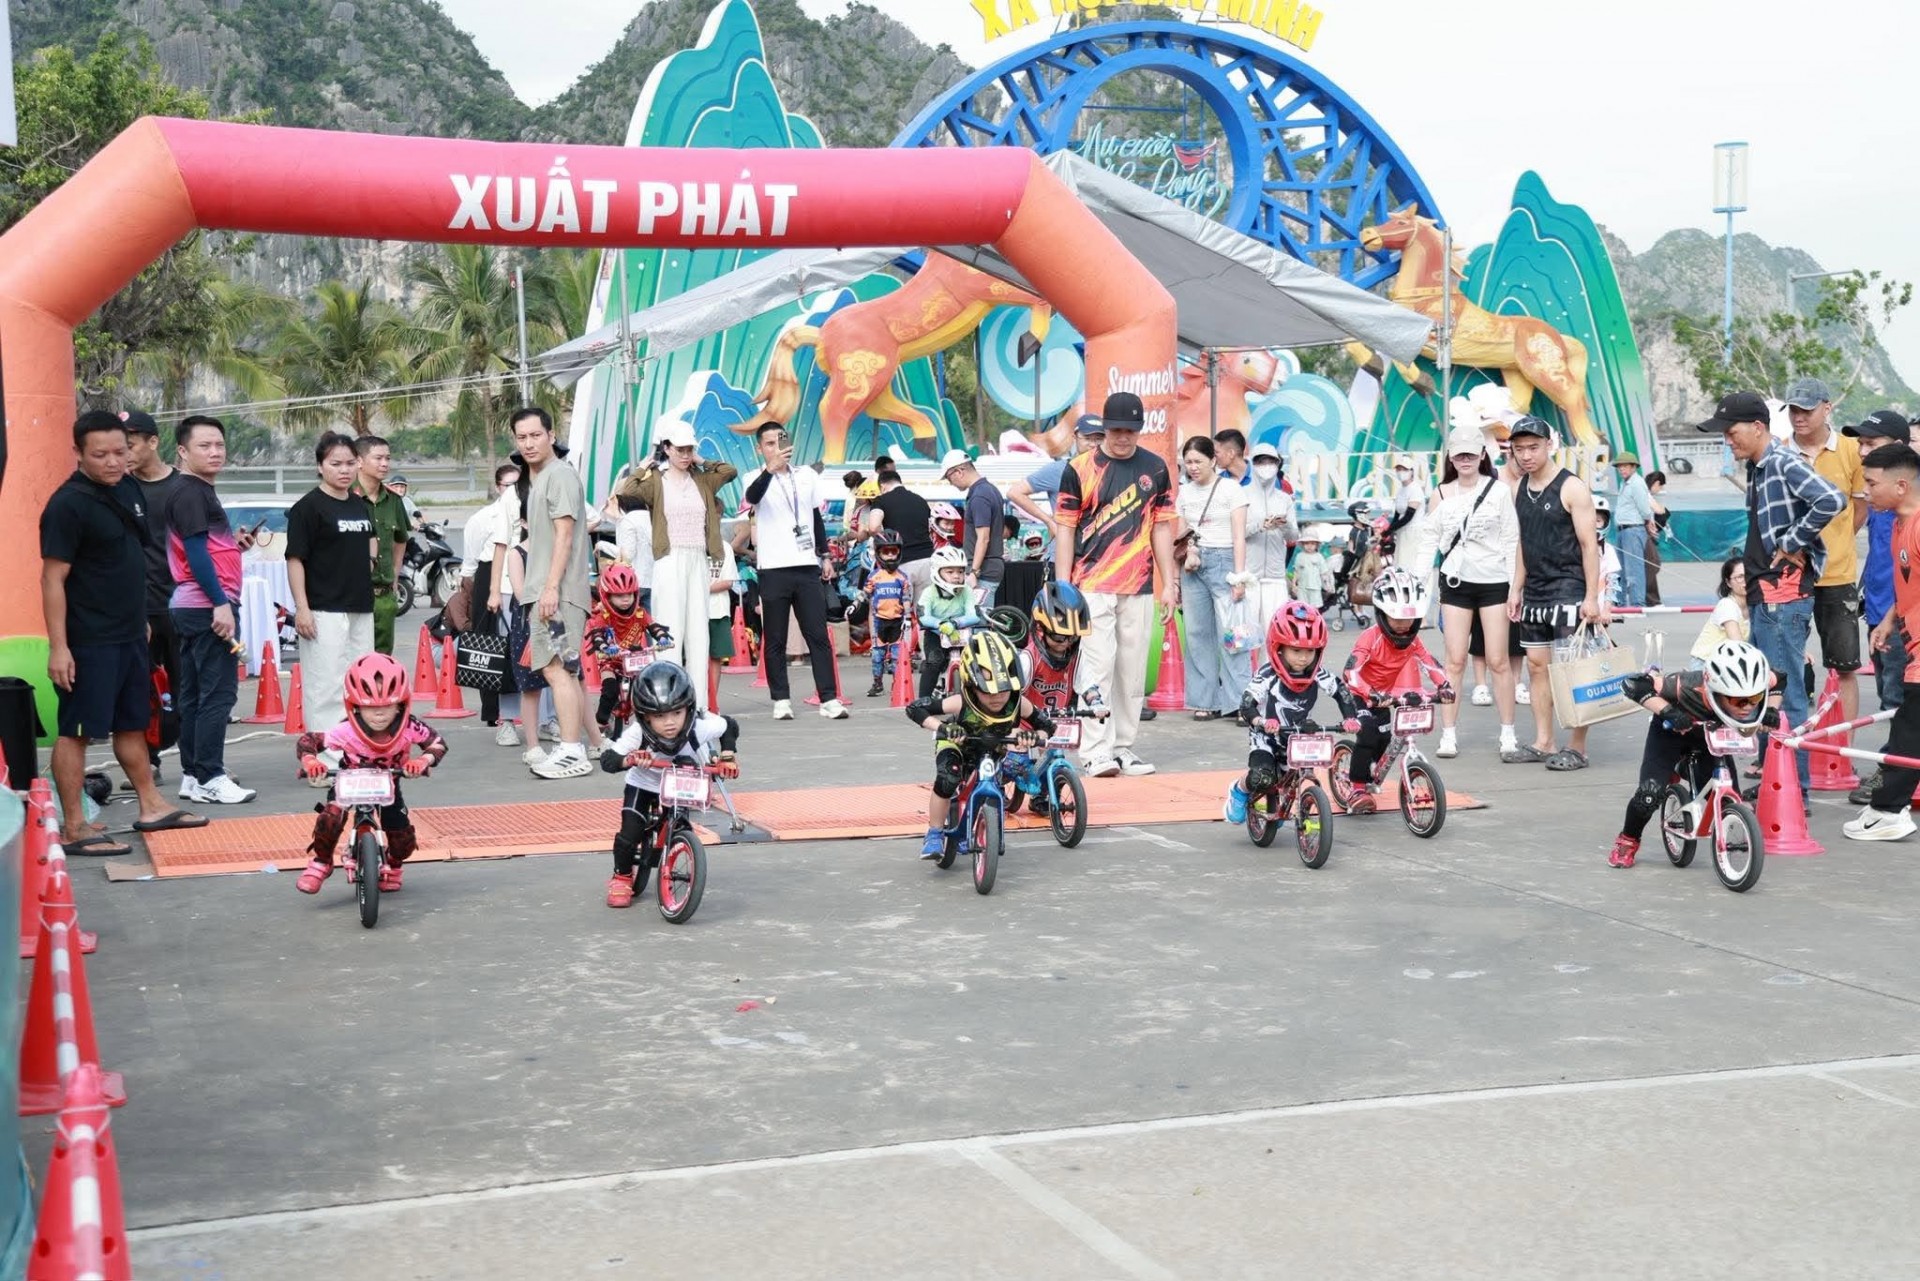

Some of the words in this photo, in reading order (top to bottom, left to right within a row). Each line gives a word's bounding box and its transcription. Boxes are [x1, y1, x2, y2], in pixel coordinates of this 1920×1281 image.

[448, 155, 618, 234] XUẤT
[637, 167, 799, 237] PHÁT
[1107, 361, 1175, 397] Summer
